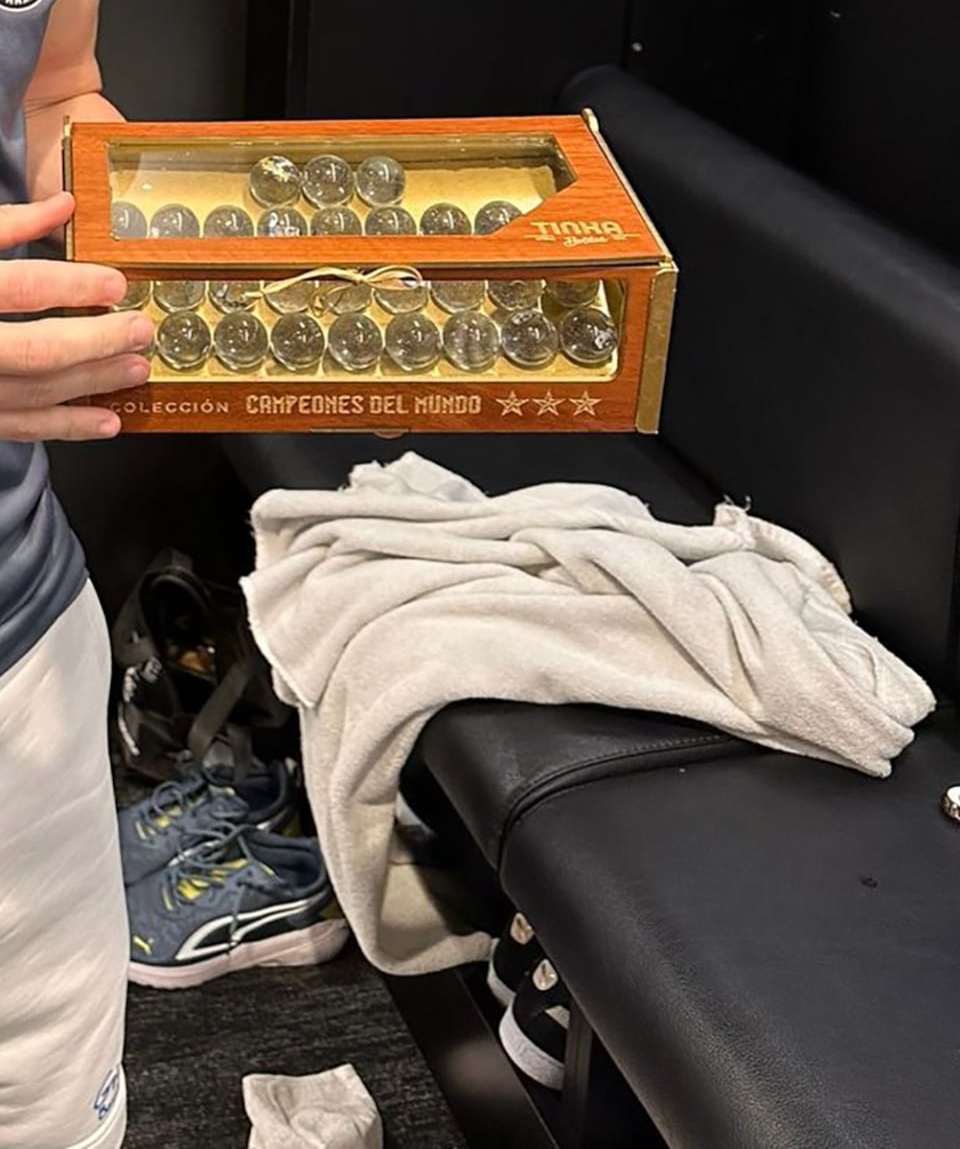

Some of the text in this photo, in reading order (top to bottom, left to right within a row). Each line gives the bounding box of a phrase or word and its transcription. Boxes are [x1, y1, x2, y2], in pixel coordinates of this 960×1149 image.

[111, 394, 482, 415] COLECCIÓN CAMPEONES DEL MUNDO
